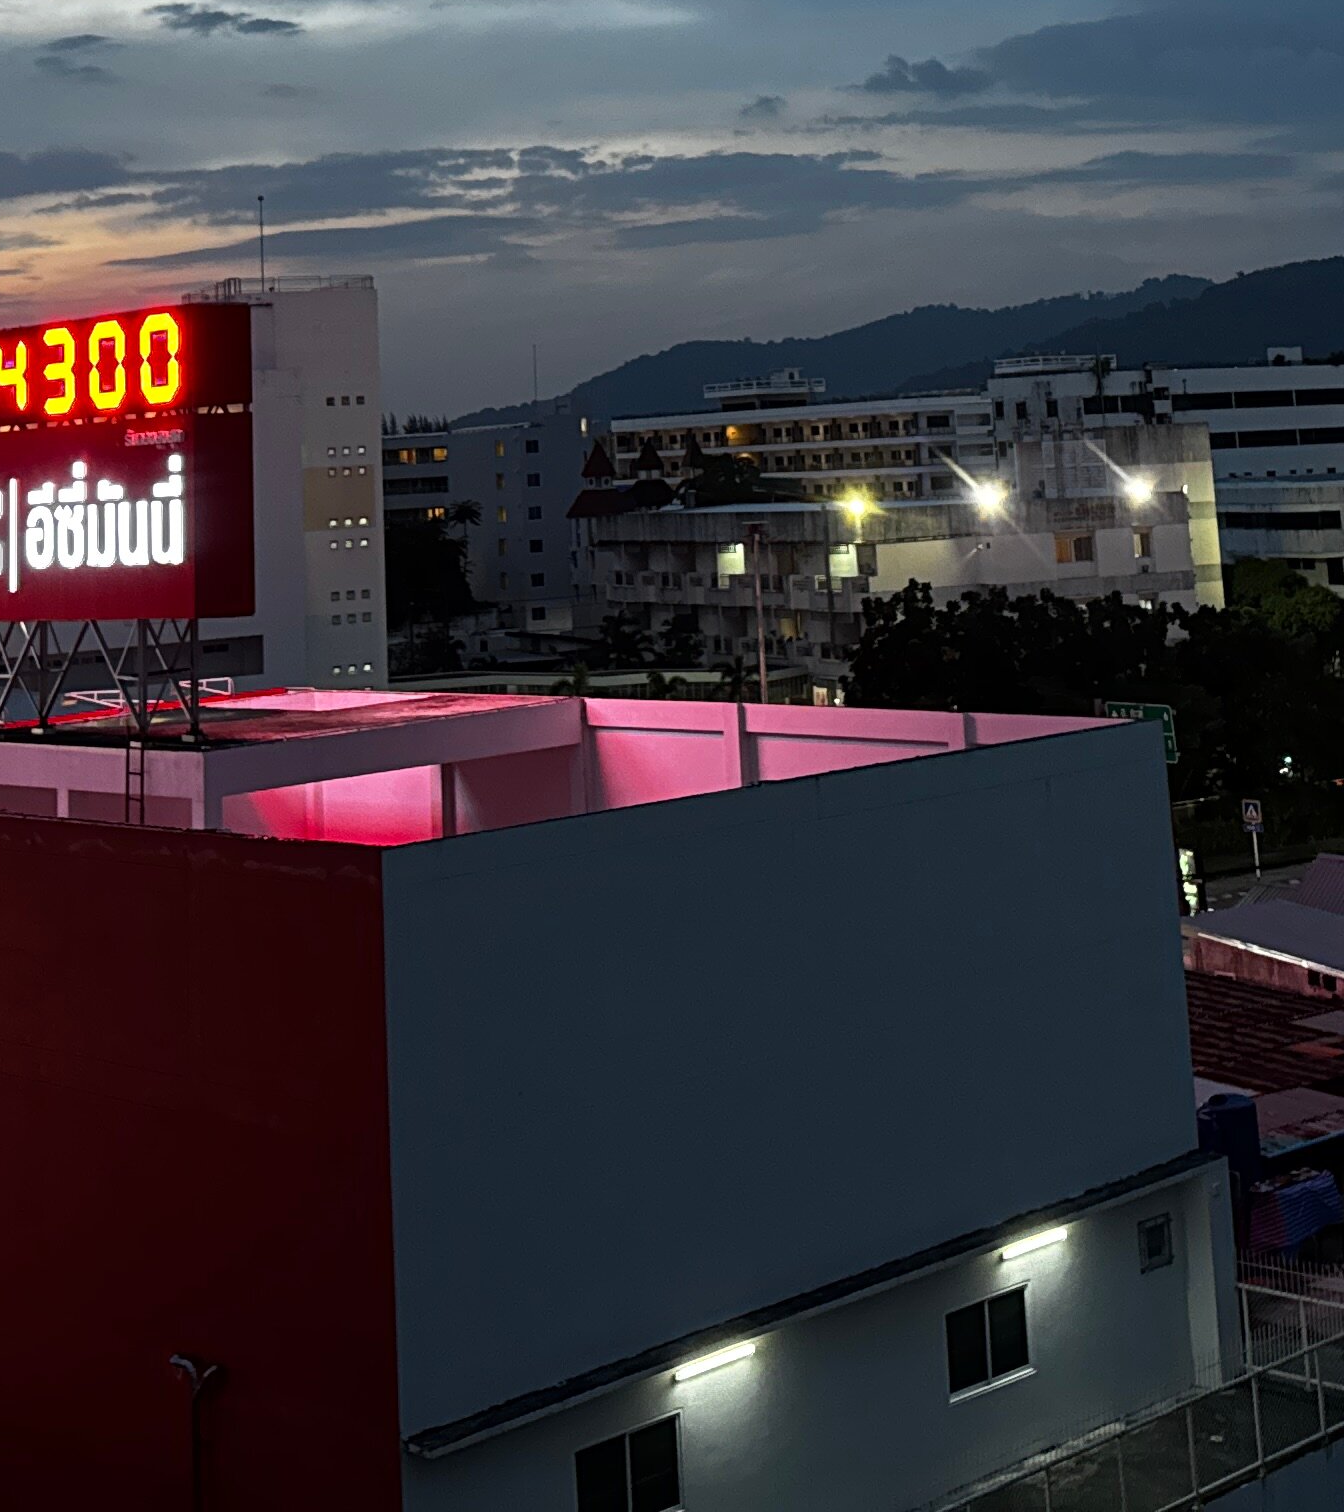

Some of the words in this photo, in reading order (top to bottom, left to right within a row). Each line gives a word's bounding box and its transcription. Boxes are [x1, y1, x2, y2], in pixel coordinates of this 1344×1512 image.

[25, 454, 184, 569] อีซี่มันนี่
